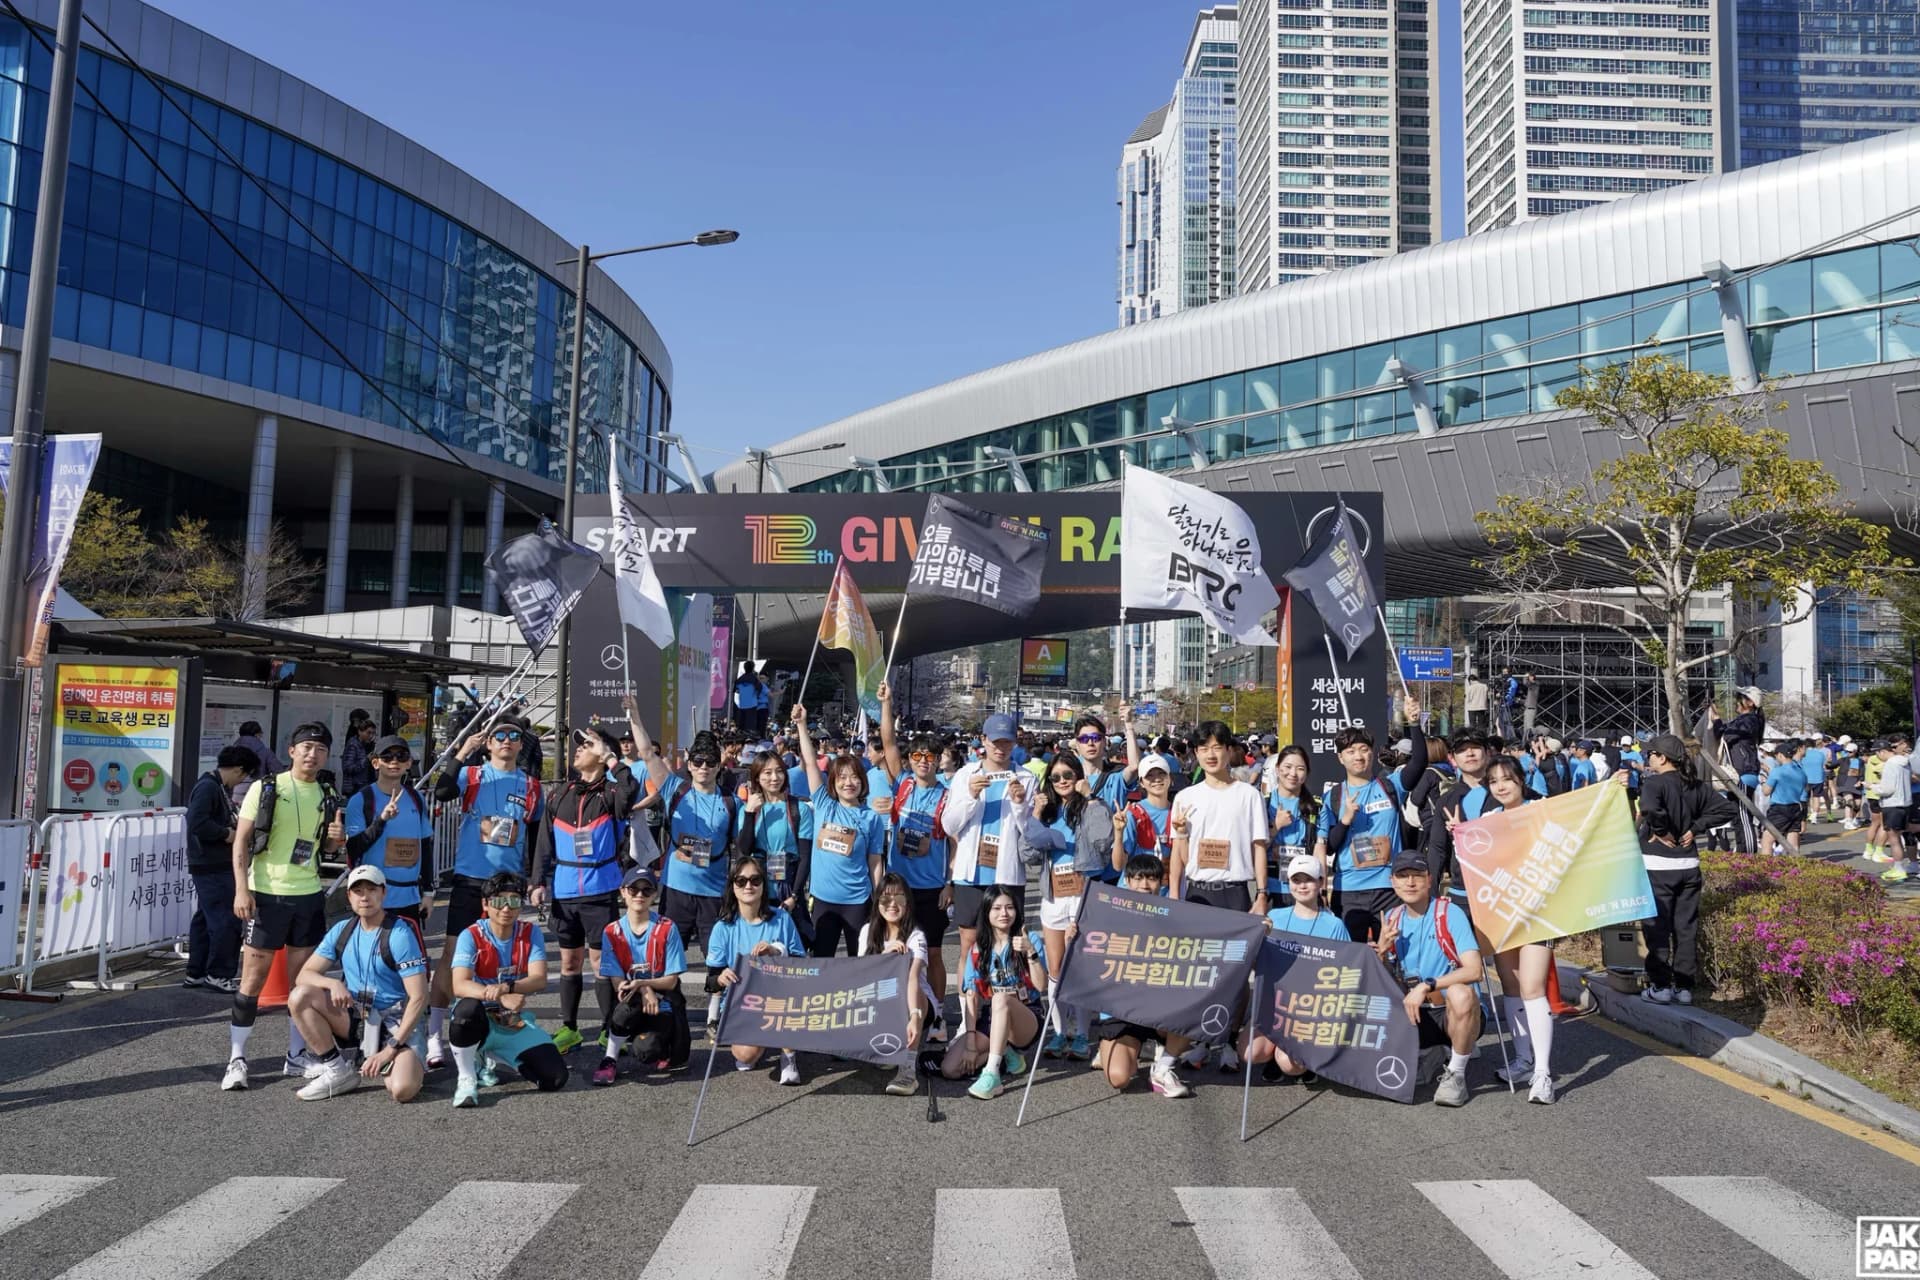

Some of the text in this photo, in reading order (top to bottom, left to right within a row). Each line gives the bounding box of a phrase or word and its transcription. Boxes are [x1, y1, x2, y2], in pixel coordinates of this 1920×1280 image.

[585, 527, 698, 553] SRT
[840, 516, 919, 563] GIV
[1061, 516, 1122, 562] RA
[921, 523, 953, 544] 오늘
[910, 564, 1001, 599] 기부합니다
[1168, 551, 1243, 612] BTRC
[589, 689, 637, 697] 사회공헌위회
[1311, 678, 1365, 694] 세상에서
[63, 688, 174, 706] 장애인 운전면허 취득
[1311, 699, 1339, 714] 가장
[65, 709, 169, 728] 무료 교육생 모집
[1311, 738, 1338, 754] 달리
[129, 879, 198, 911] 사회공헌위
[1477, 867, 1513, 911] 오늘
[1112, 897, 1133, 909] GIVE
[1145, 905, 1170, 917] RACE
[1622, 895, 1649, 908] RACE
[1279, 941, 1301, 954] GIVE
[1312, 946, 1336, 959] RACE
[399, 957, 427, 970] BTRC
[762, 964, 783, 974] GIVE
[795, 967, 820, 976] RACE
[1100, 959, 1218, 988] 기부합니다
[1314, 966, 1362, 990] 오늘
[760, 1005, 877, 1032] 기부합니다
[1272, 1012, 1388, 1050] 기부합니다
